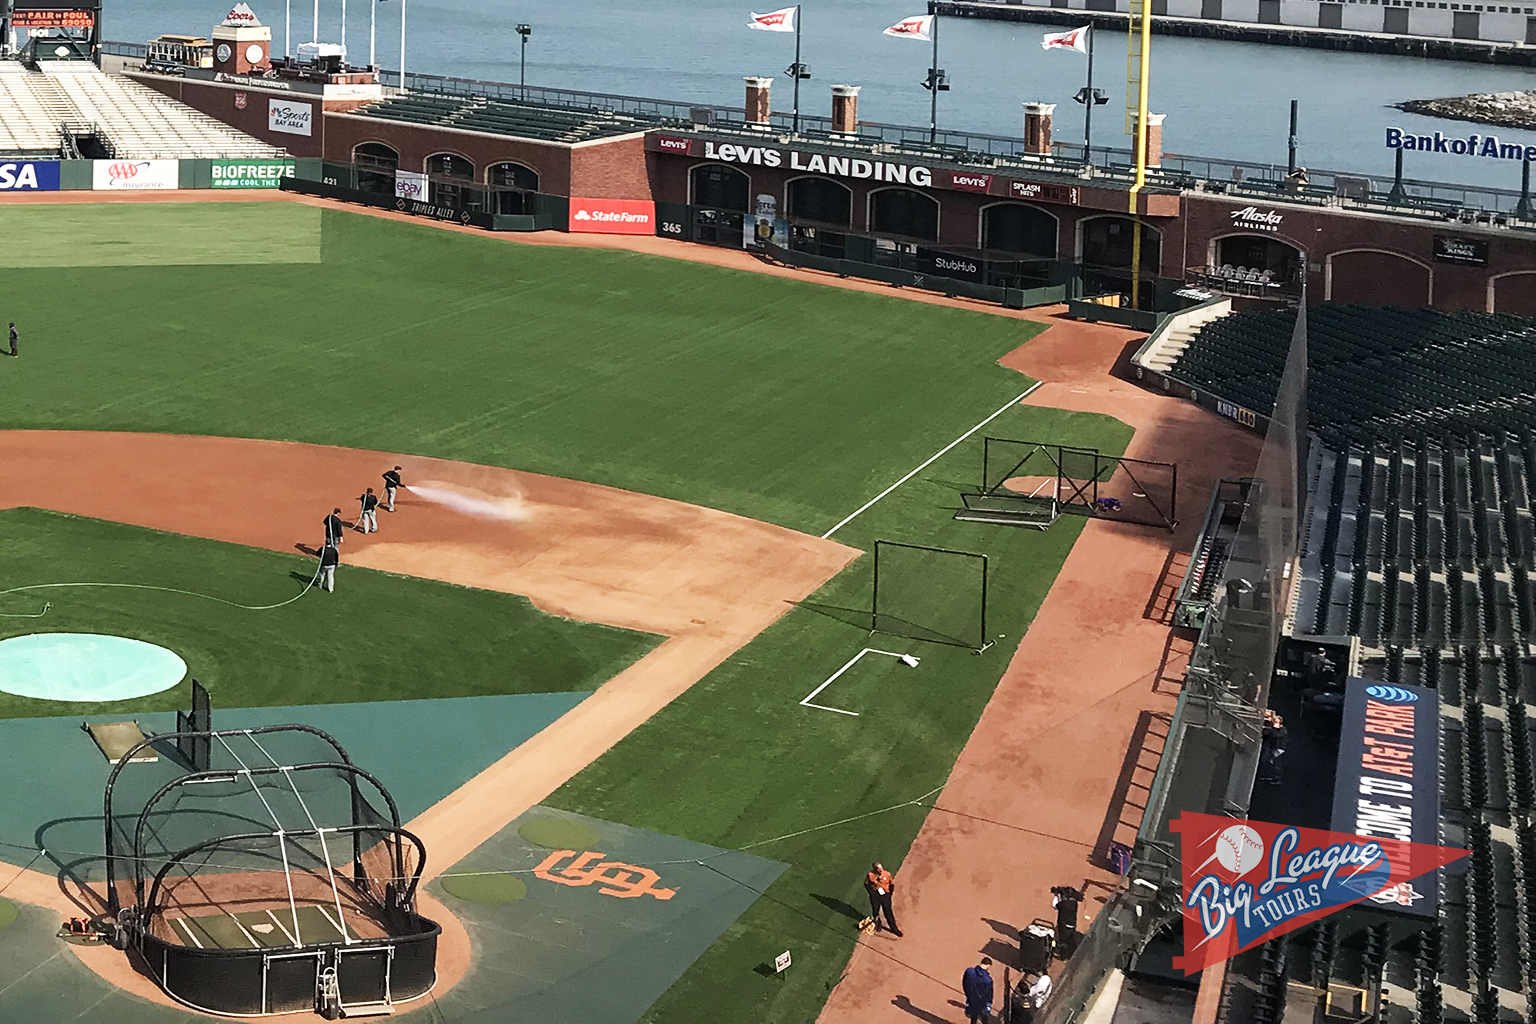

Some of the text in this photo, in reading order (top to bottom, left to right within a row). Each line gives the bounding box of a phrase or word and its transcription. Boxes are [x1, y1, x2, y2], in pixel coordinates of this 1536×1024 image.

[226, 9, 255, 21] Coors
[280, 107, 310, 122] Sports
[288, 120, 304, 129] AREA
[1386, 127, 1450, 153] Bank
[1452, 133, 1480, 155] of
[790, 151, 932, 187] LANDING
[122, 181, 164, 189] insurance
[323, 177, 337, 186] 421
[396, 179, 423, 195] ebay
[1013, 182, 1041, 193] SPLASH
[412, 202, 455, 219] TRIPLES ALLEY
[1230, 206, 1283, 225] Alaska
[662, 222, 682, 234] 365
[1233, 220, 1278, 232] AIRLINES
[935, 257, 977, 273] StubHub
[1365, 699, 1415, 739] PARK
[1361, 736, 1414, 778] AT&T
[1359, 775, 1413, 800] TO
